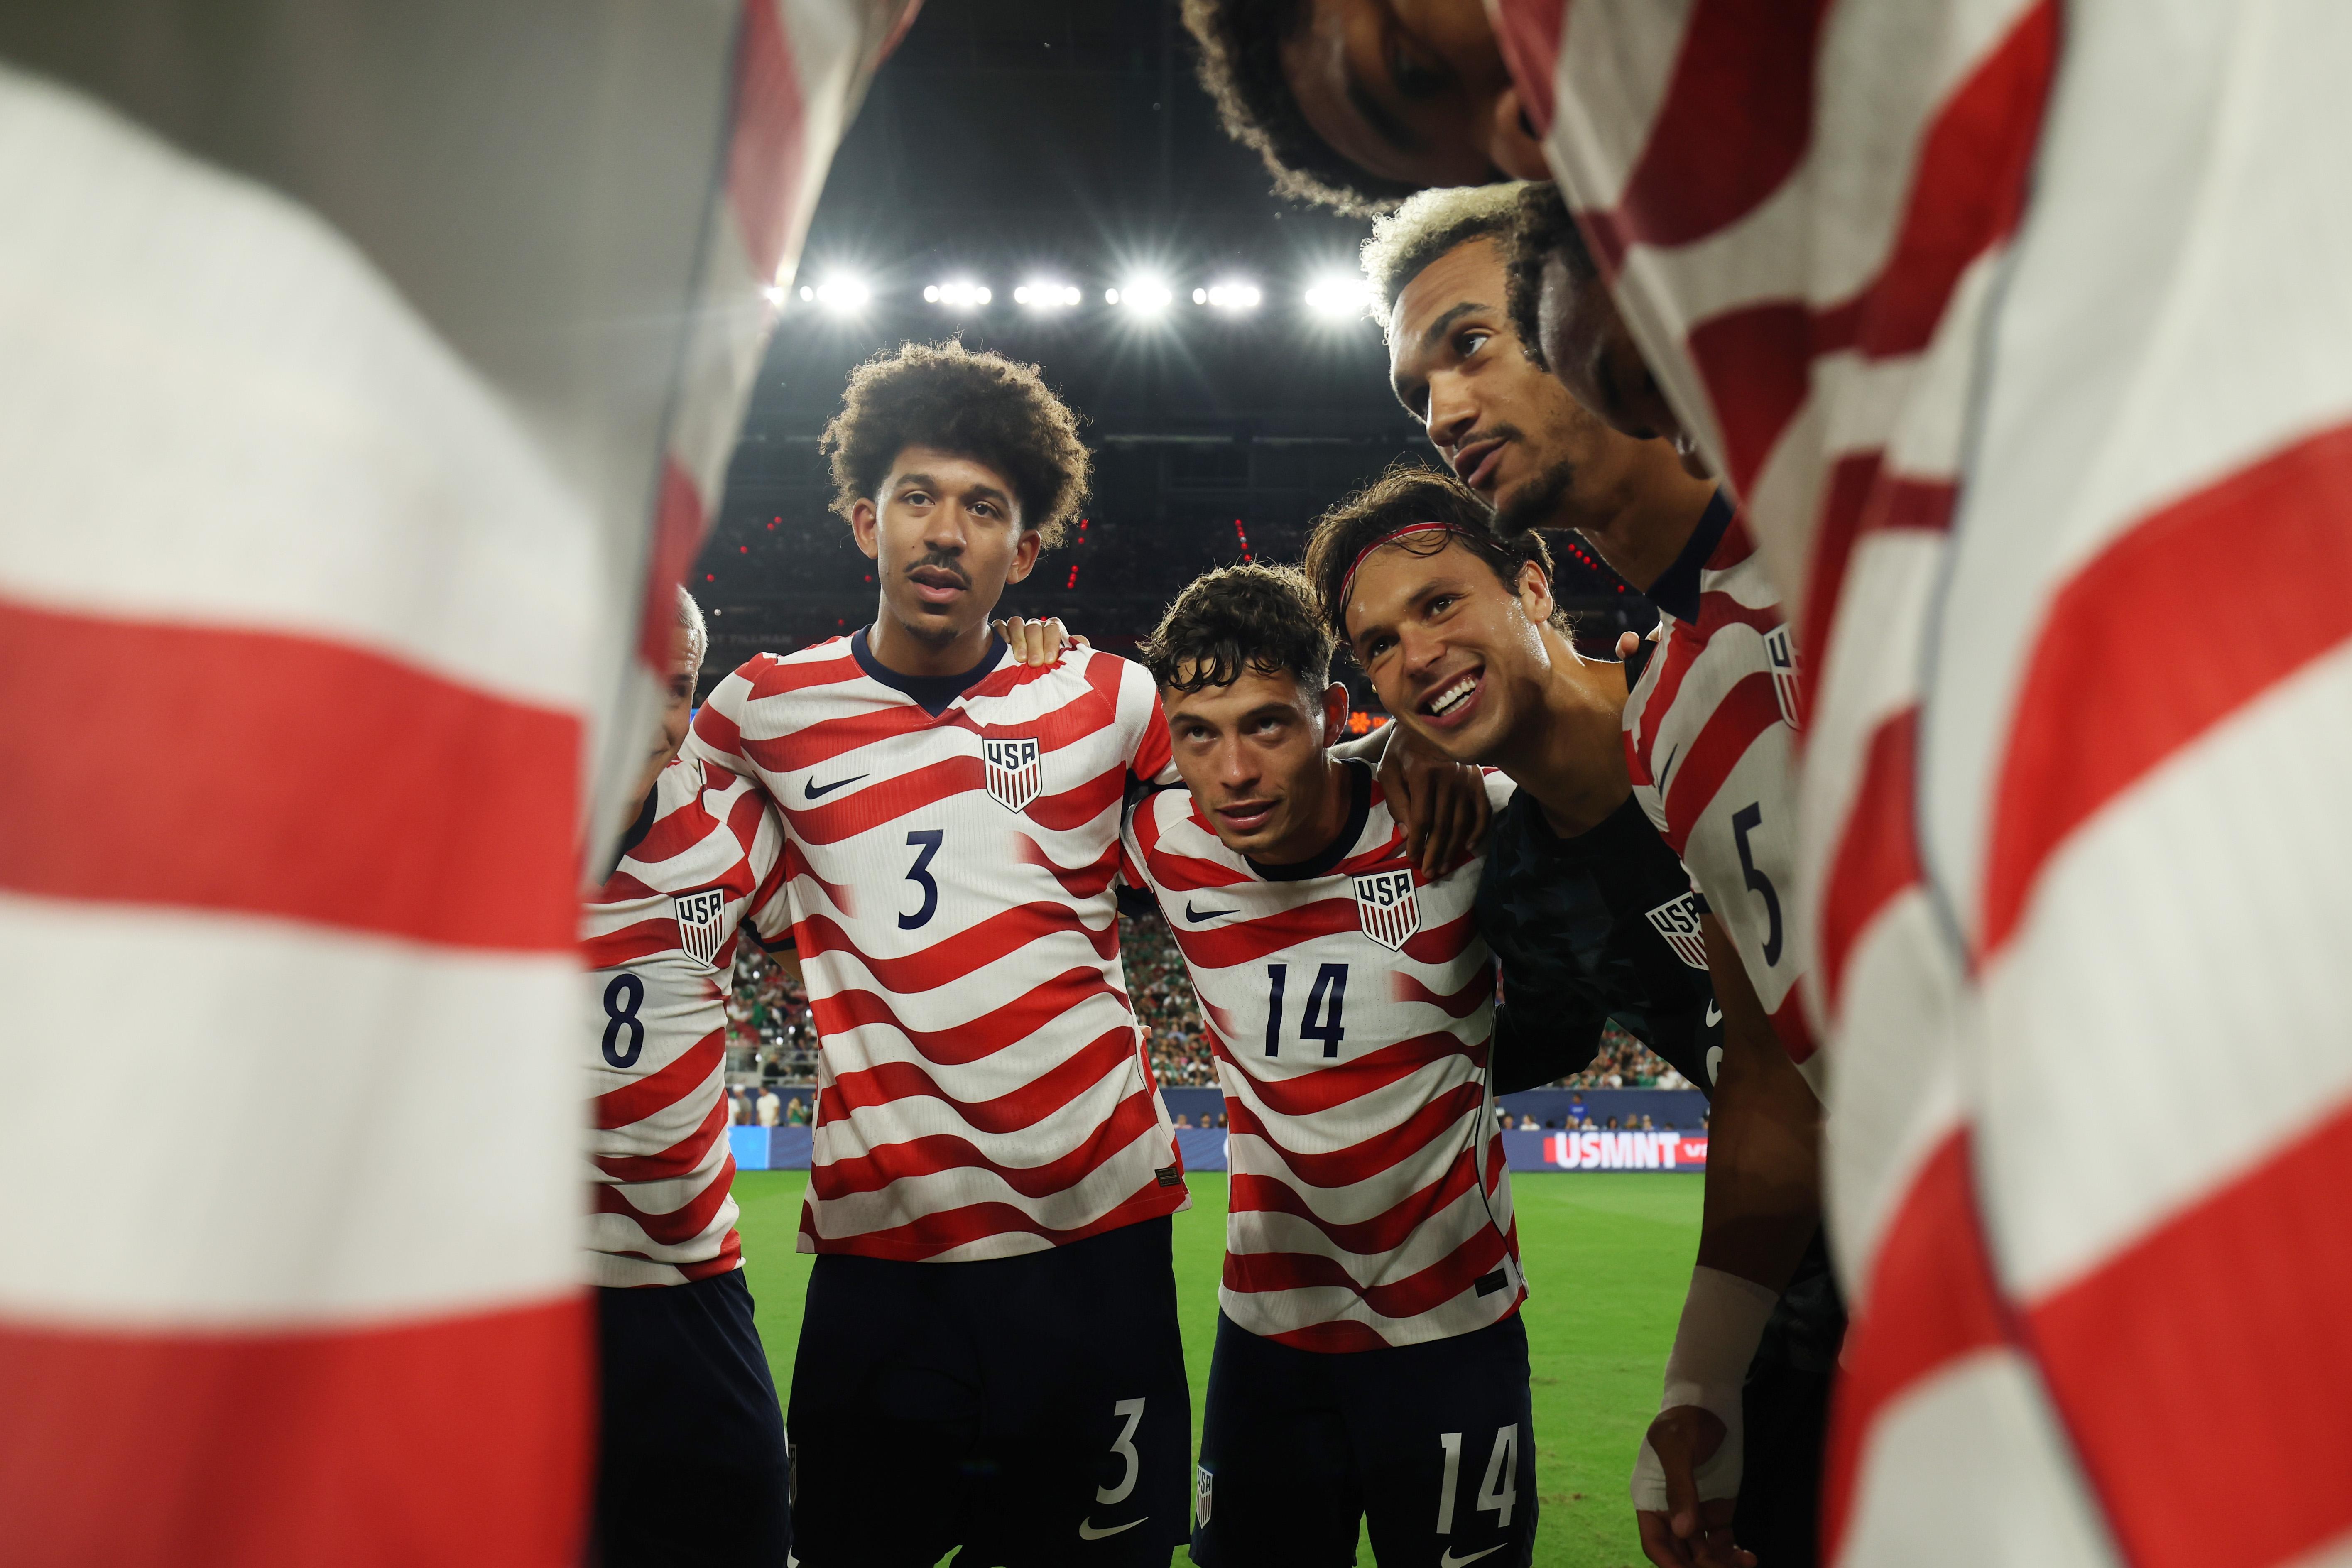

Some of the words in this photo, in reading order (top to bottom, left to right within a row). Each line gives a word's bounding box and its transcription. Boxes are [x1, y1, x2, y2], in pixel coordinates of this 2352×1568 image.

[988, 742, 1035, 770] USA
[679, 893, 721, 924] USA
[898, 829, 944, 930] 3
[1358, 873, 1410, 906] USA
[1732, 801, 1783, 967] 5
[602, 973, 644, 1068] 8
[1265, 963, 1349, 1058] 14
[1555, 1132, 1681, 1169] USMNT
[1096, 1397, 1146, 1504] 3
[1198, 1468, 1211, 1494] USA
[1436, 1422, 1518, 1534] 14
